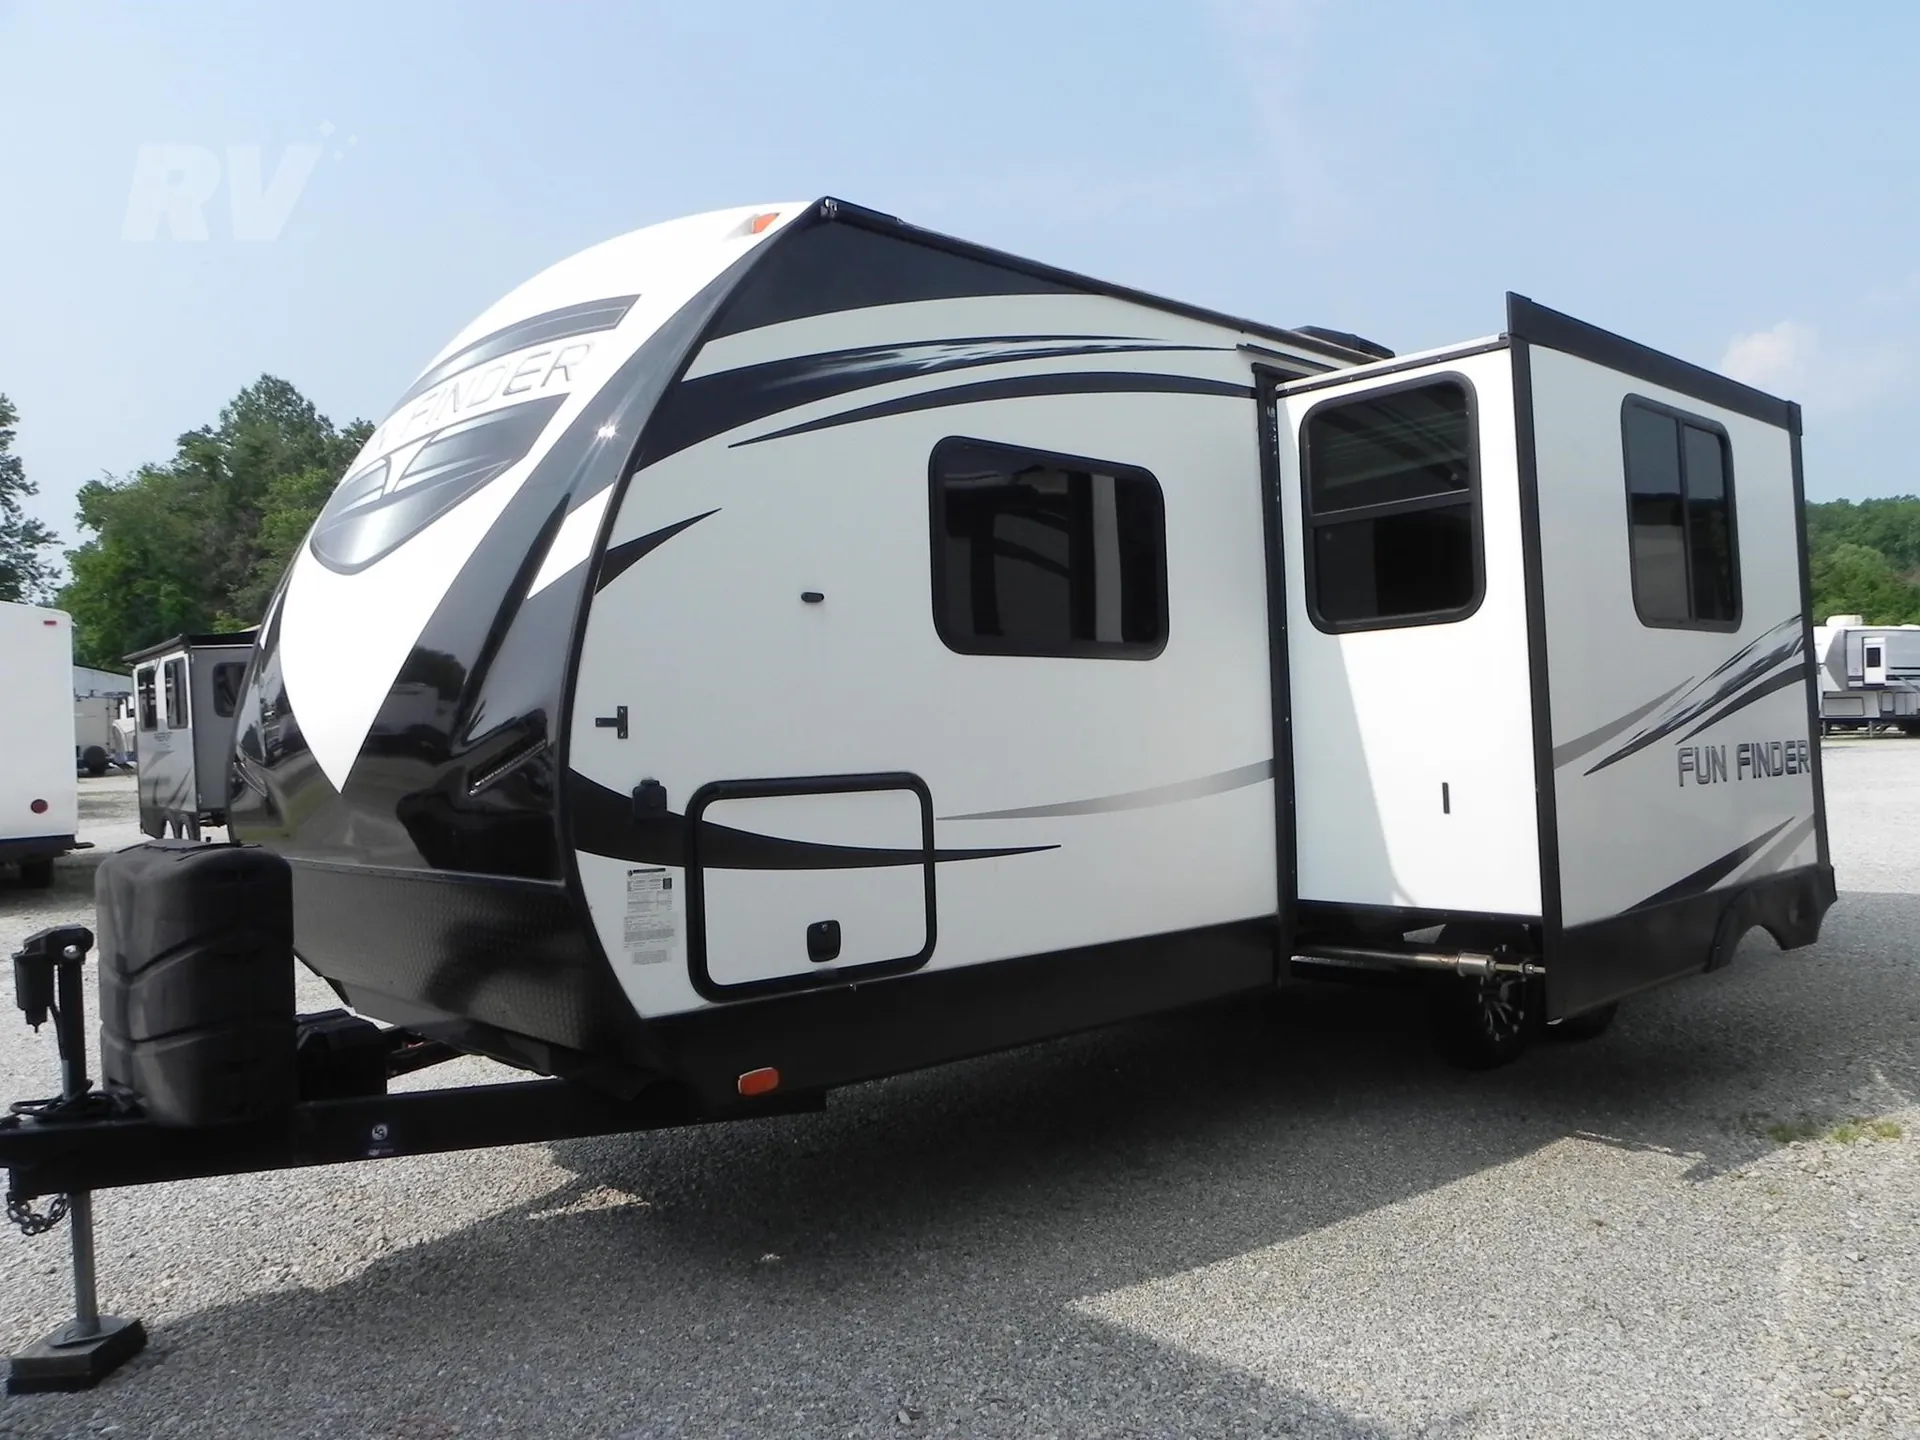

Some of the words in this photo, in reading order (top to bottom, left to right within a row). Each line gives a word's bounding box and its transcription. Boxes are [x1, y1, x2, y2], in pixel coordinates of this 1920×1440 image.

[399, 340, 596, 438] FINDER
[1677, 746, 1728, 787] FUN
[1736, 739, 1811, 781] FINDER
